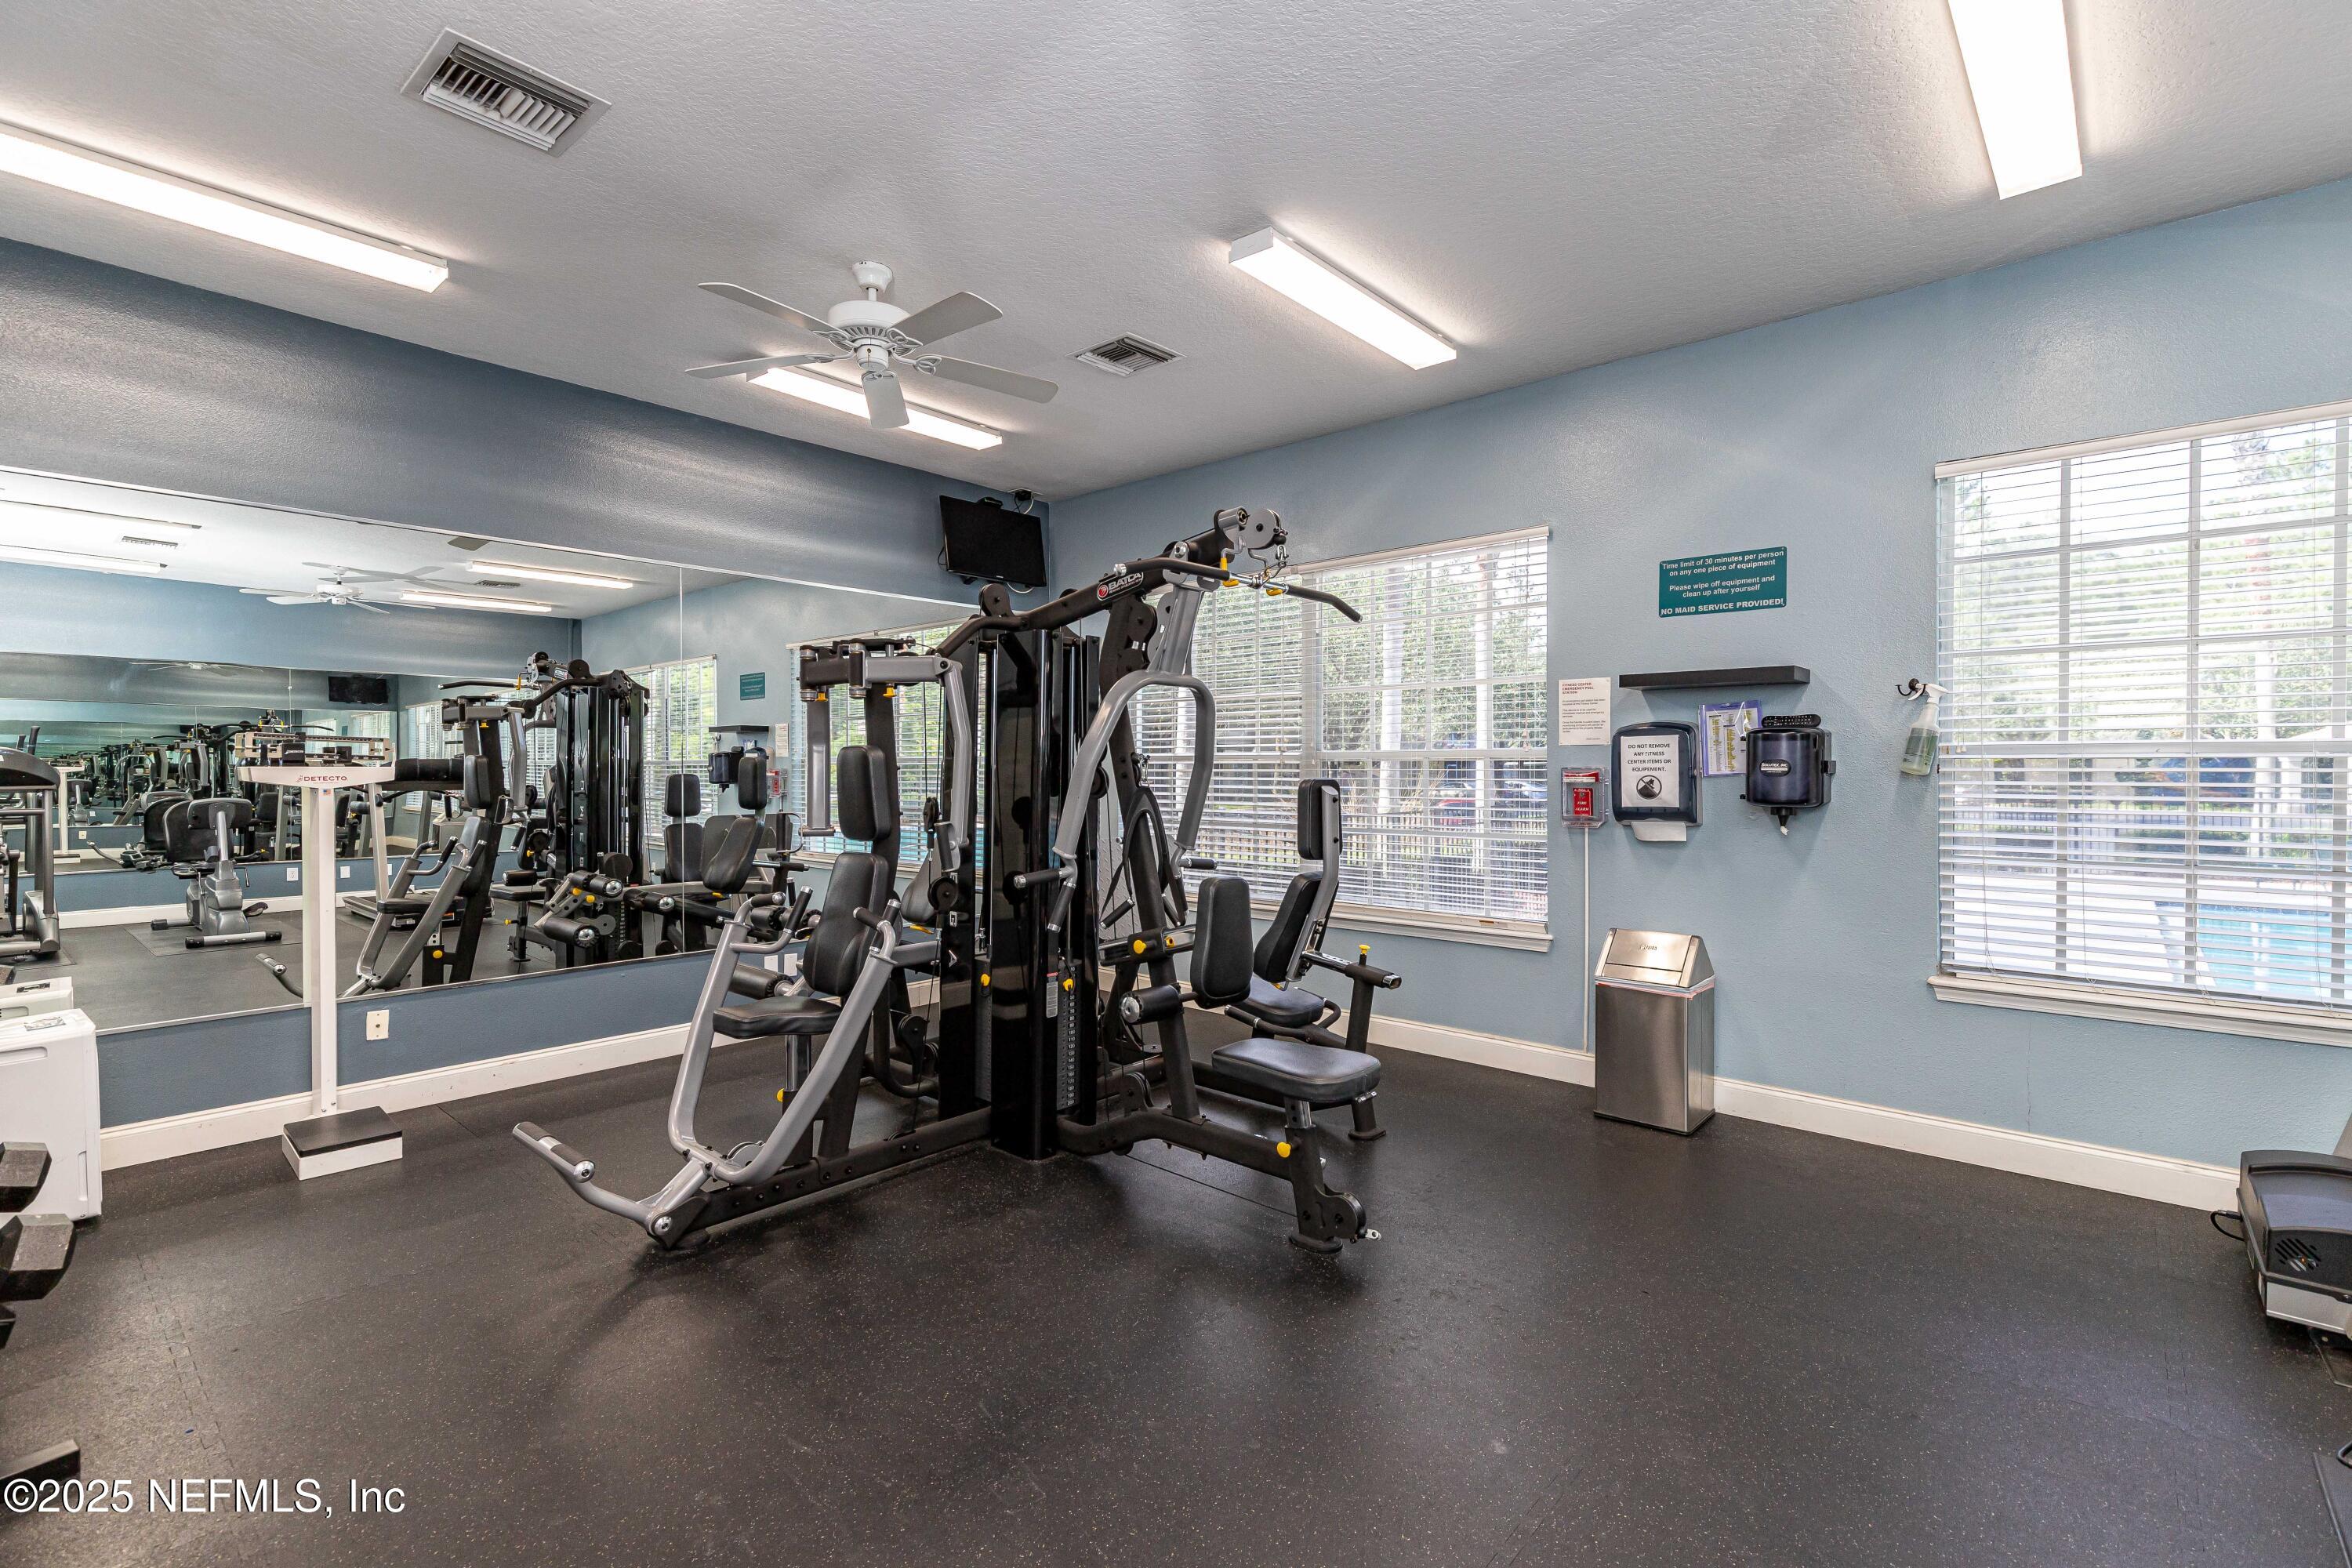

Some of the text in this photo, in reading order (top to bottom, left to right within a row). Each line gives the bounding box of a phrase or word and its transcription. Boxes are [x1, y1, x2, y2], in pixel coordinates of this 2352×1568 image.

[1758, 551, 1784, 559] person
[1737, 560, 1775, 569] equipment
[1722, 578, 1759, 586] equipment
[1731, 584, 1761, 594] yourself
[1698, 603, 1734, 611] SERVICE
[1736, 598, 1783, 608] PROVIDED!
